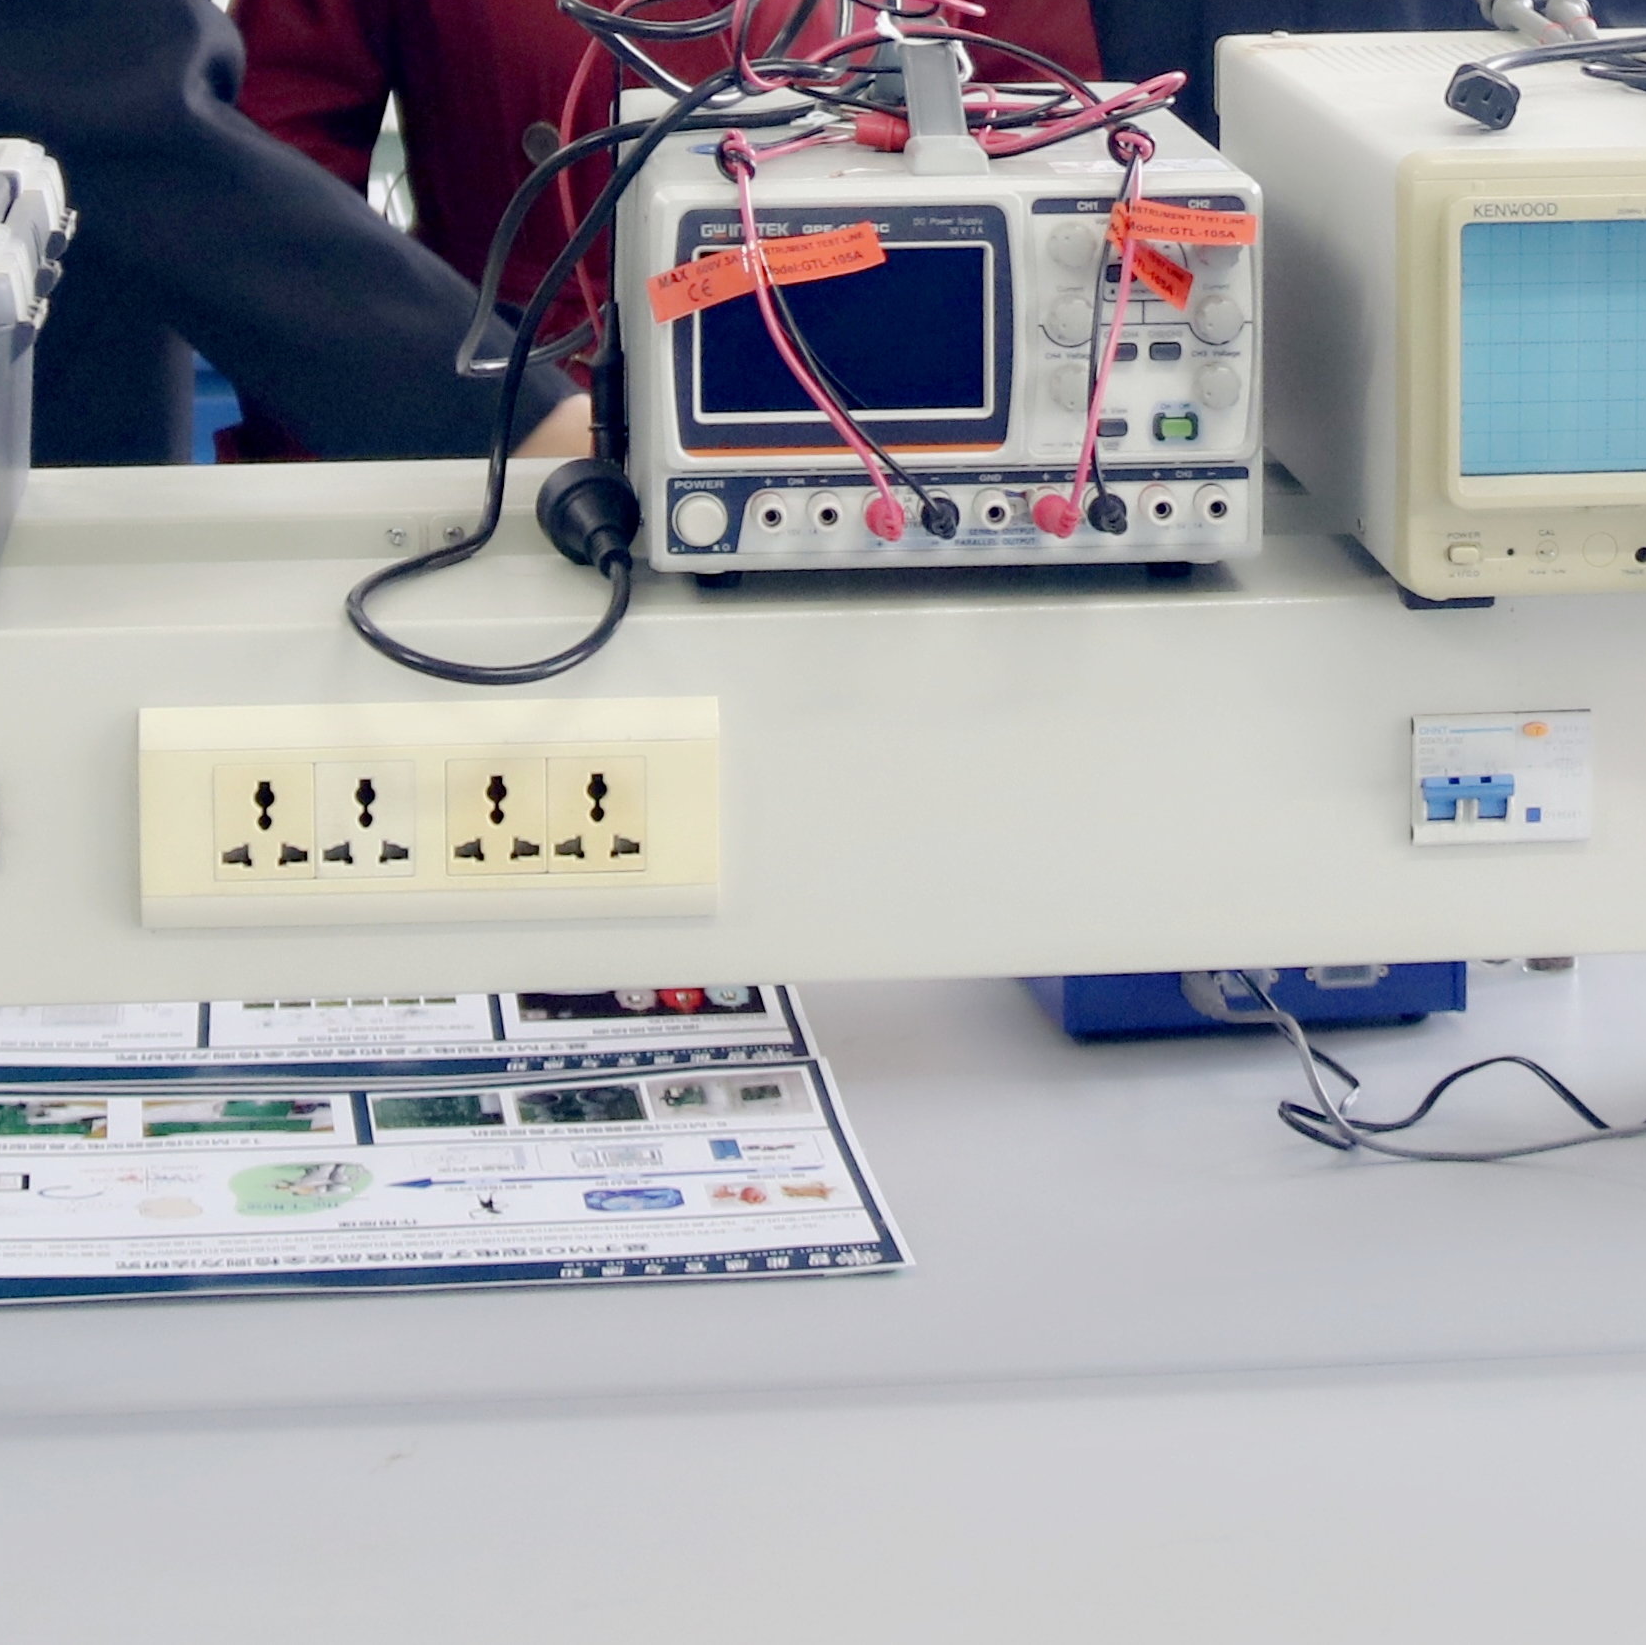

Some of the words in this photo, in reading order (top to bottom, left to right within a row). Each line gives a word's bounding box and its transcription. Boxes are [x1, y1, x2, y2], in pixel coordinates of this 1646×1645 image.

[1076, 201, 1099, 212] CH1
[1187, 199, 1211, 209] CH2
[1473, 202, 1558, 218] KENWOOD
[912, 217, 927, 227] DC
[929, 216, 954, 226] Power
[957, 217, 984, 227] Supply
[1195, 214, 1219, 224] TEST
[657, 269, 689, 290] MAX
[687, 278, 713, 303] CE
[978, 472, 1003, 482] GND
[674, 479, 725, 490] POWER
[1002, 536, 1036, 545] OUTPUT
[114, 1243, 649, 1271] 基于MOS型电子鼻的食品安全检测方法研究
[559, 1252, 833, 1279] 智能感官与感知
